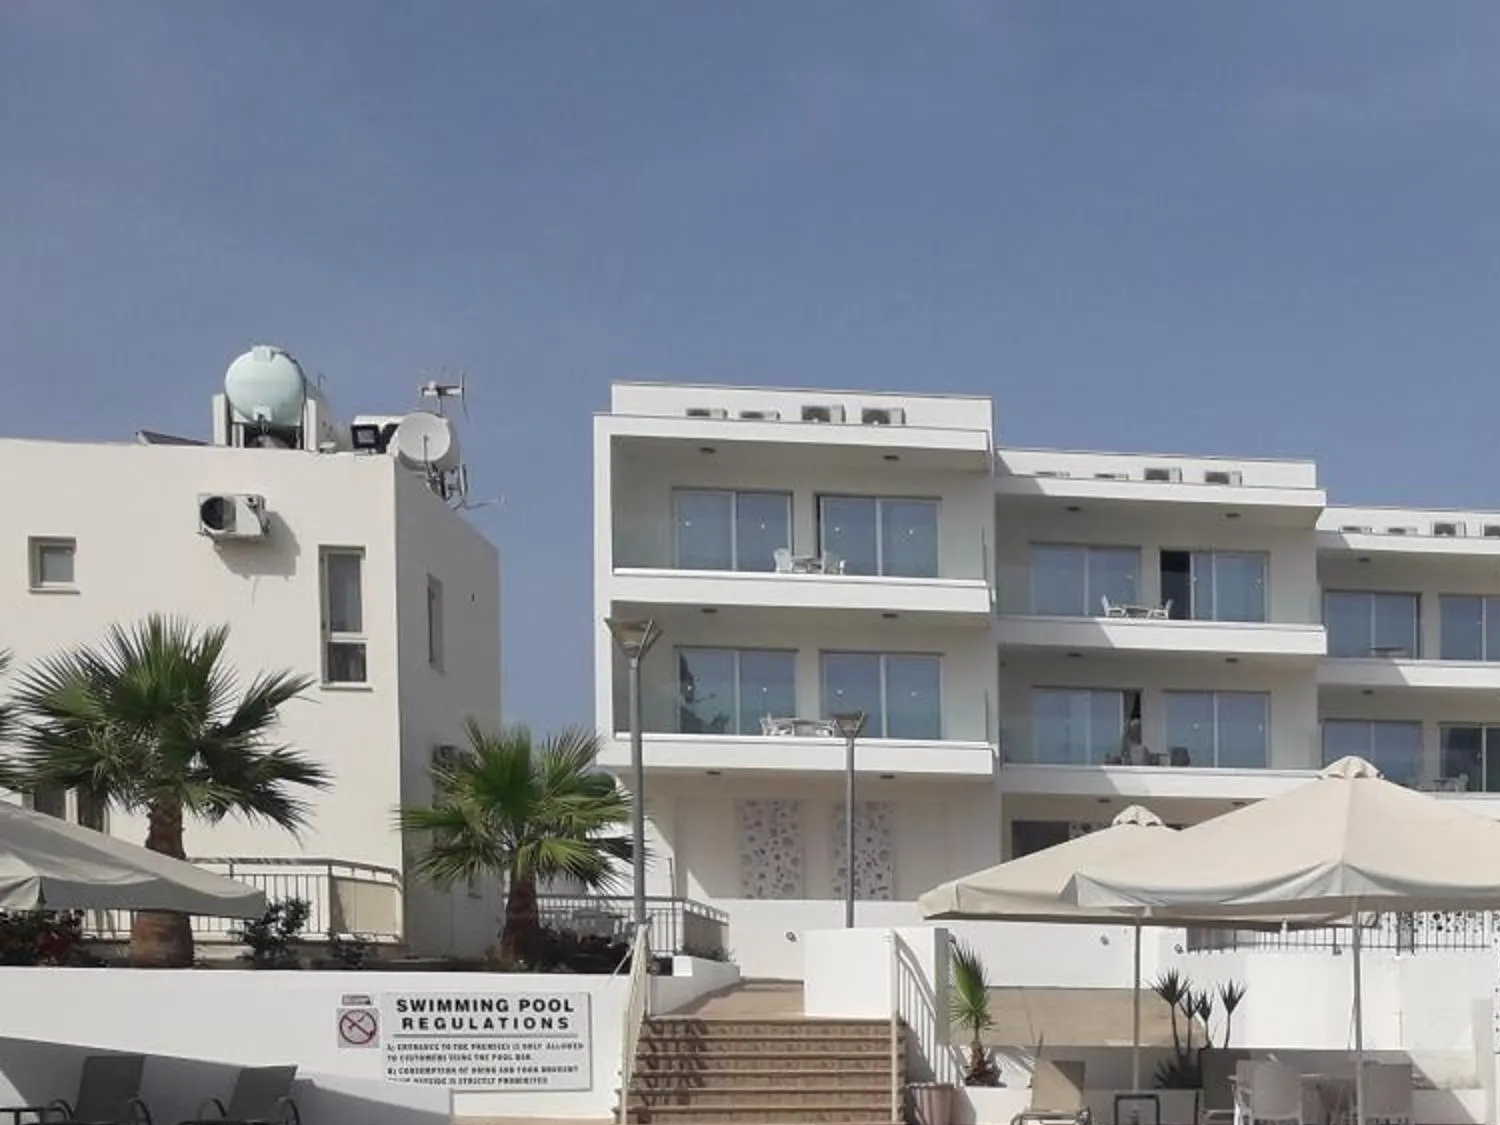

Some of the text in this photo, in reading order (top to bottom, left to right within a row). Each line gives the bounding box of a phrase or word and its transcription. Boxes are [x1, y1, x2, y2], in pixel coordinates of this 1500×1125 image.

[396, 998, 575, 1014] SWIMMING POOL
[401, 1016, 570, 1030] REGULATIONS
